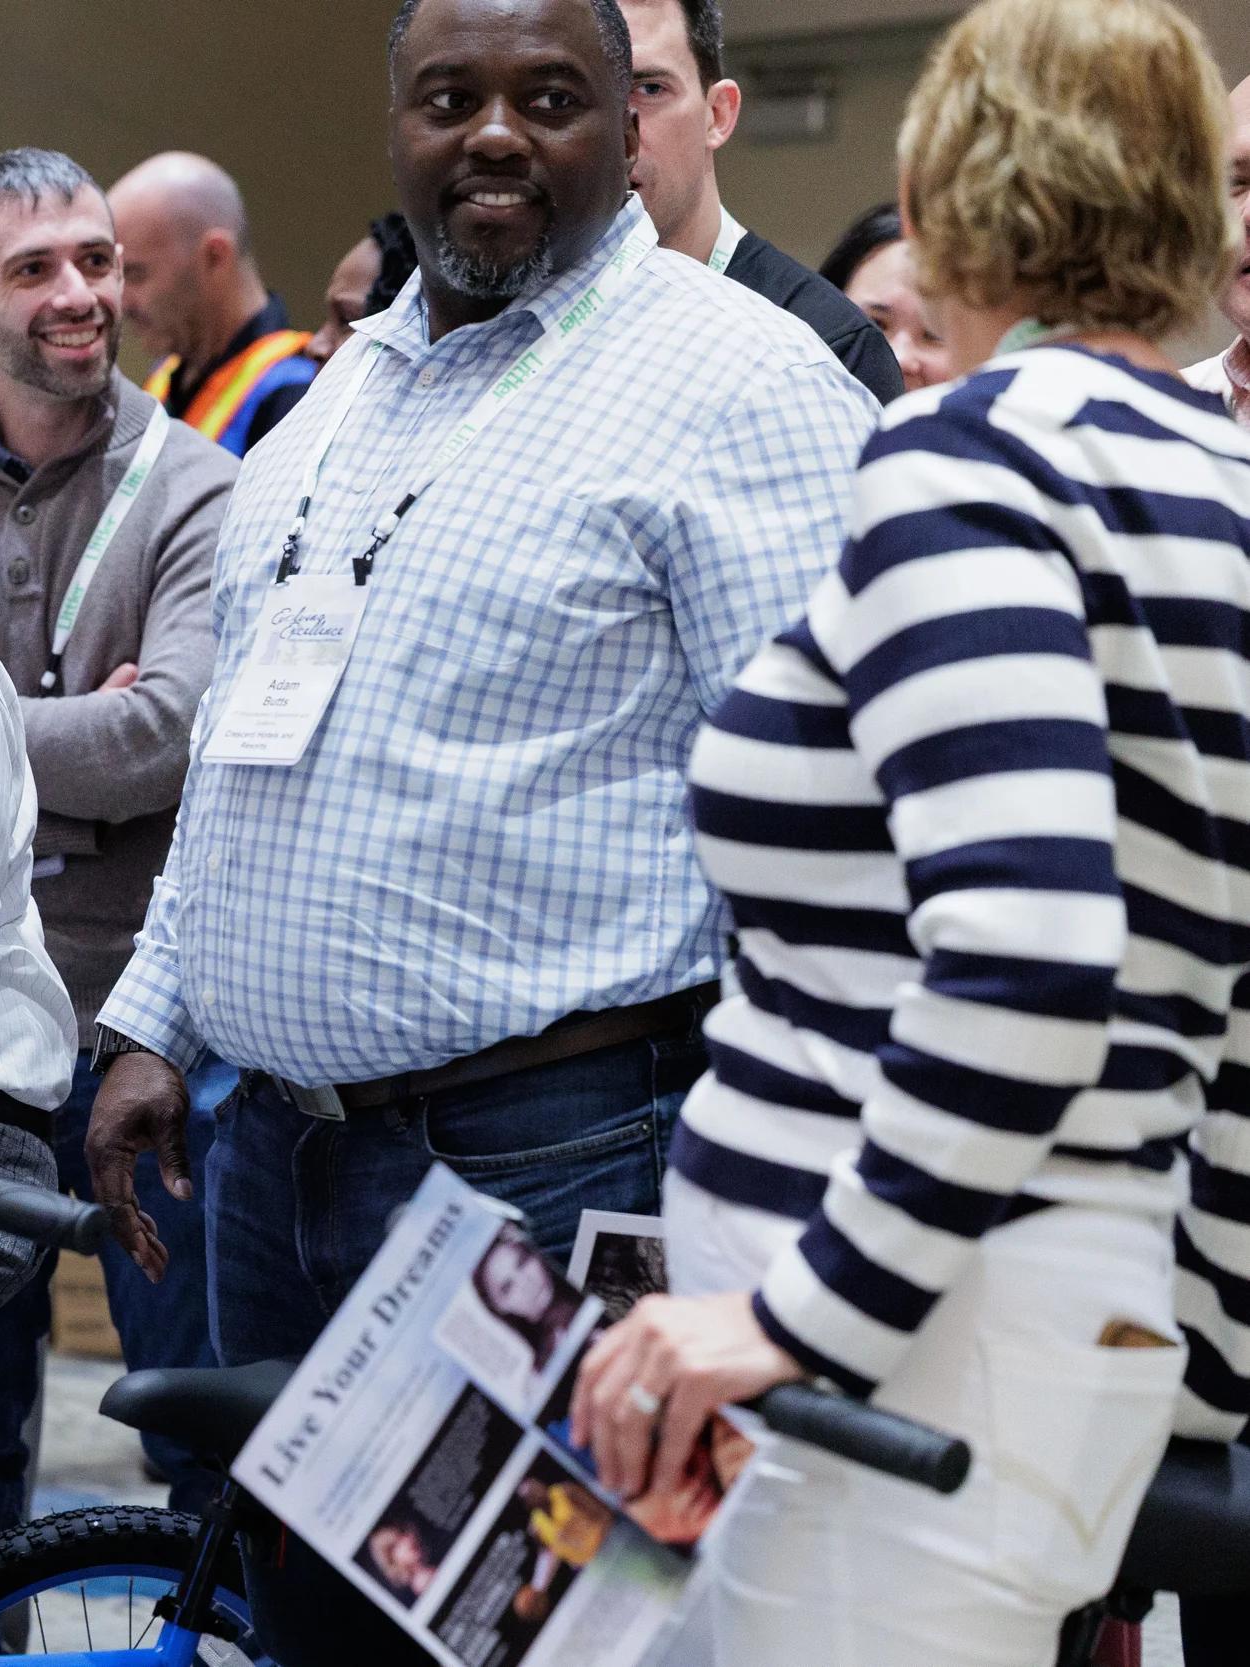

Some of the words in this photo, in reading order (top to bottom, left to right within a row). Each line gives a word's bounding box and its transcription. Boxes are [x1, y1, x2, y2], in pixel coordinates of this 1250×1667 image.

[558, 287, 605, 338] Littler
[492, 351, 545, 402] Littler
[84, 515, 116, 560] Littler
[57, 582, 85, 630] Littler
[262, 695, 290, 707] Butts
[267, 679, 301, 691] Adam
[225, 730, 256, 739] Crescent
[256, 731, 279, 739] Hotels
[280, 732, 295, 740] and
[258, 1414, 324, 1491] Live
[310, 1330, 381, 1411] Your
[375, 1202, 463, 1329] Dreams
